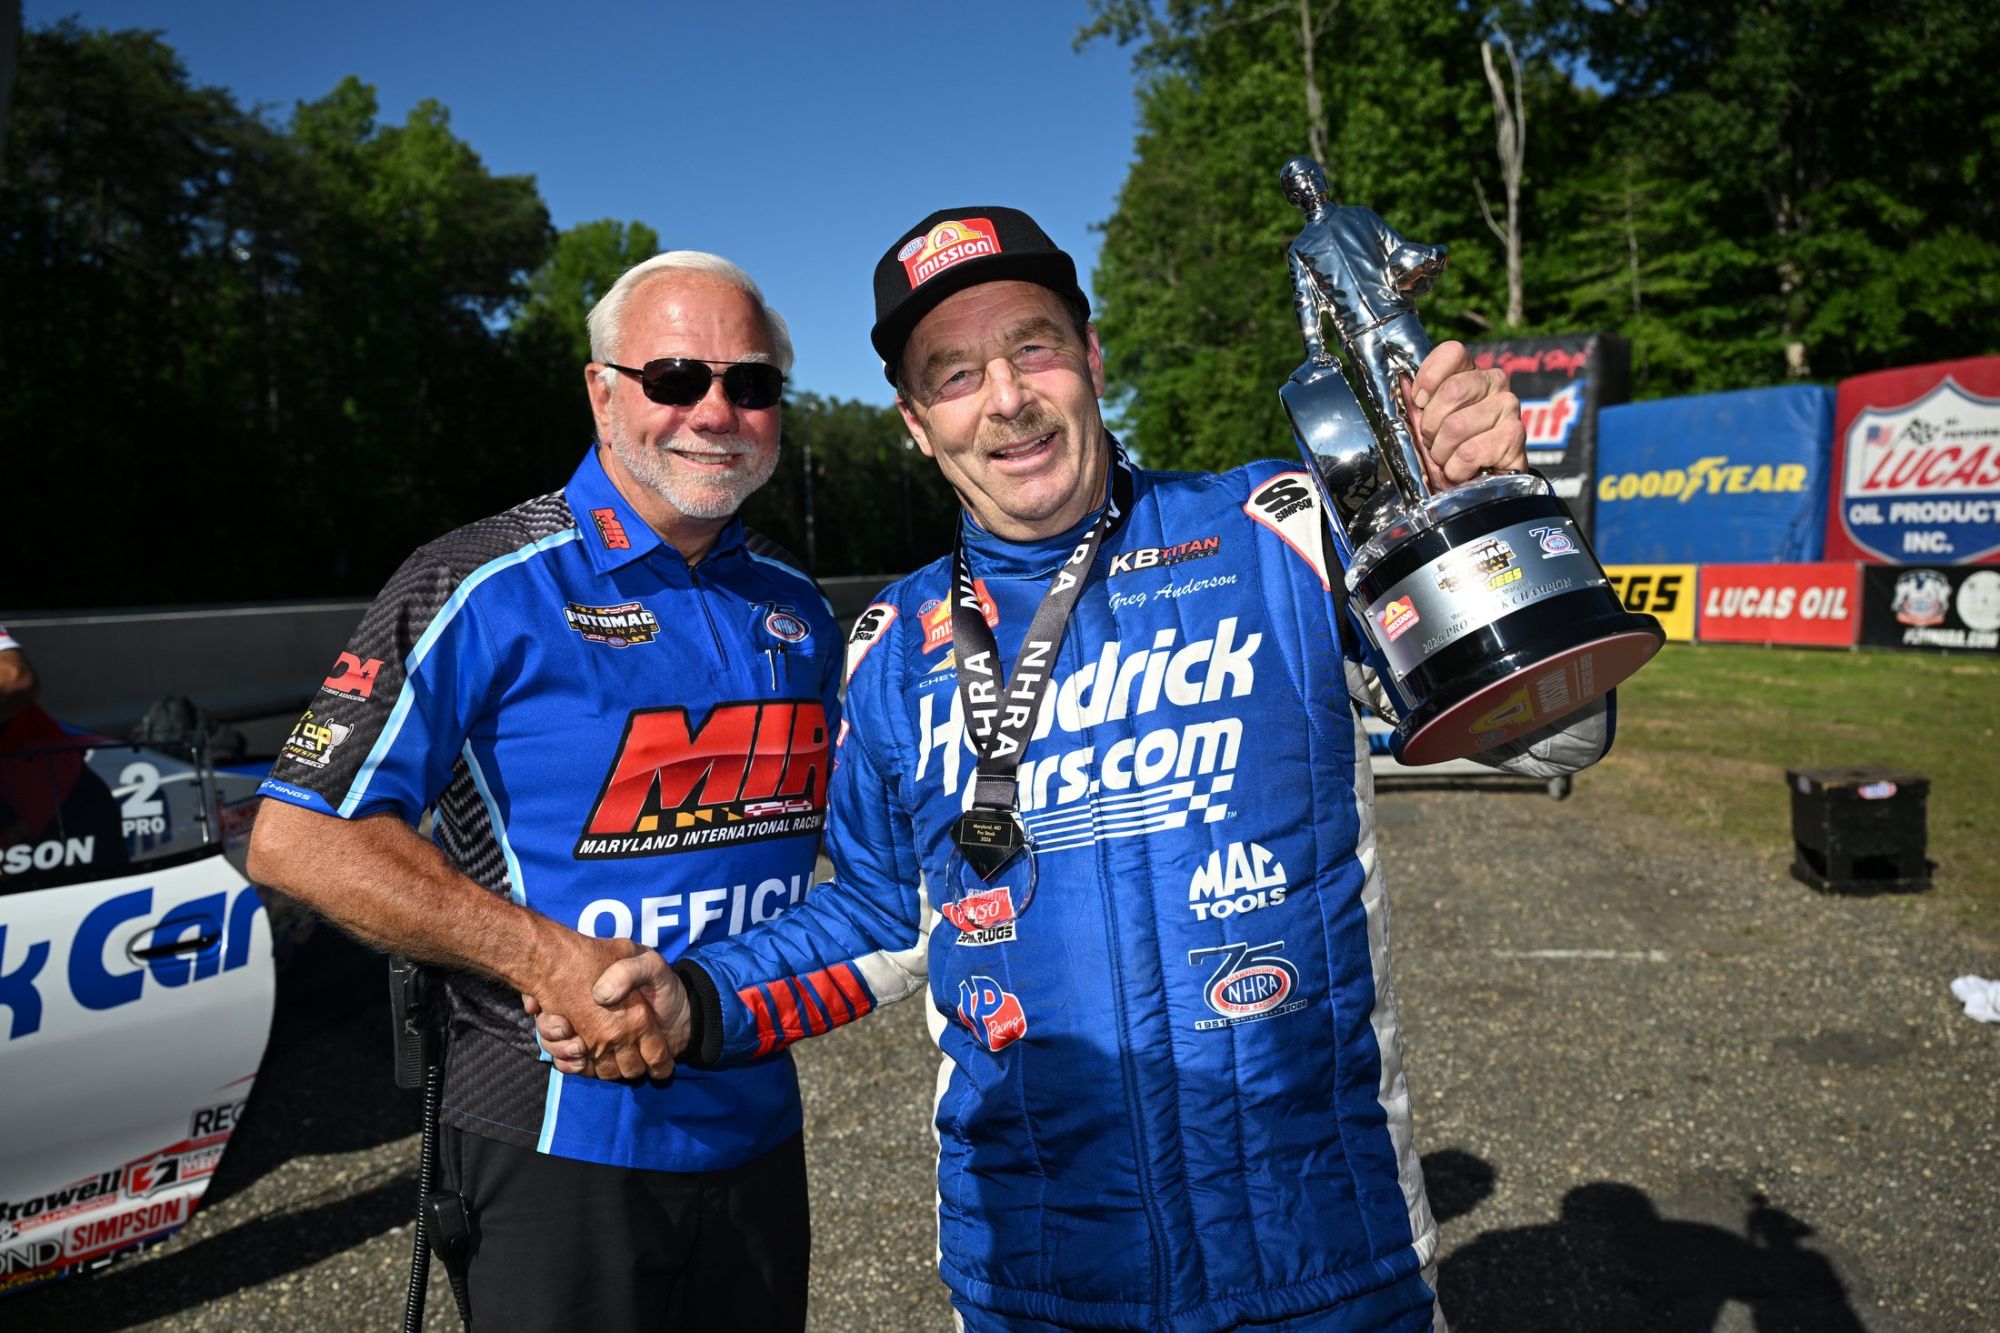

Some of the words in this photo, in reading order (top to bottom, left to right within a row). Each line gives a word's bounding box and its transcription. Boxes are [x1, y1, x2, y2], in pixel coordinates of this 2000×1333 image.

[918, 240, 989, 279] mission
[1597, 456, 1807, 503] GOODYEAR
[1850, 503, 1884, 525] OIL
[1160, 536, 1220, 559] TITAN
[1903, 530, 1954, 553] INC.
[1109, 592, 1147, 614] Greg
[1154, 573, 1238, 600] Anderson
[1511, 578, 1572, 606] CHAMPION
[1705, 587, 1797, 619] LUCAS
[1800, 586, 1848, 619] OIL
[566, 610, 655, 629] POTOMAC
[570, 622, 660, 635] NATIONALS
[964, 651, 998, 750] HRA
[990, 641, 1052, 759] NHRA
[588, 703, 829, 834] MIR
[118, 762, 163, 819] 2
[121, 815, 166, 838] PRO
[579, 834, 679, 854] MARYLAND
[682, 817, 791, 846] INTERNATIONAL
[0, 836, 95, 876] SON
[1189, 841, 1287, 902] MAC
[577, 871, 815, 949] OFFICI
[1189, 887, 1287, 921] TOOLS
[1227, 975, 1279, 1004] NHRA
[1196, 1020, 1227, 1030] 1951
[70, 1197, 181, 1252] SIMPSON
